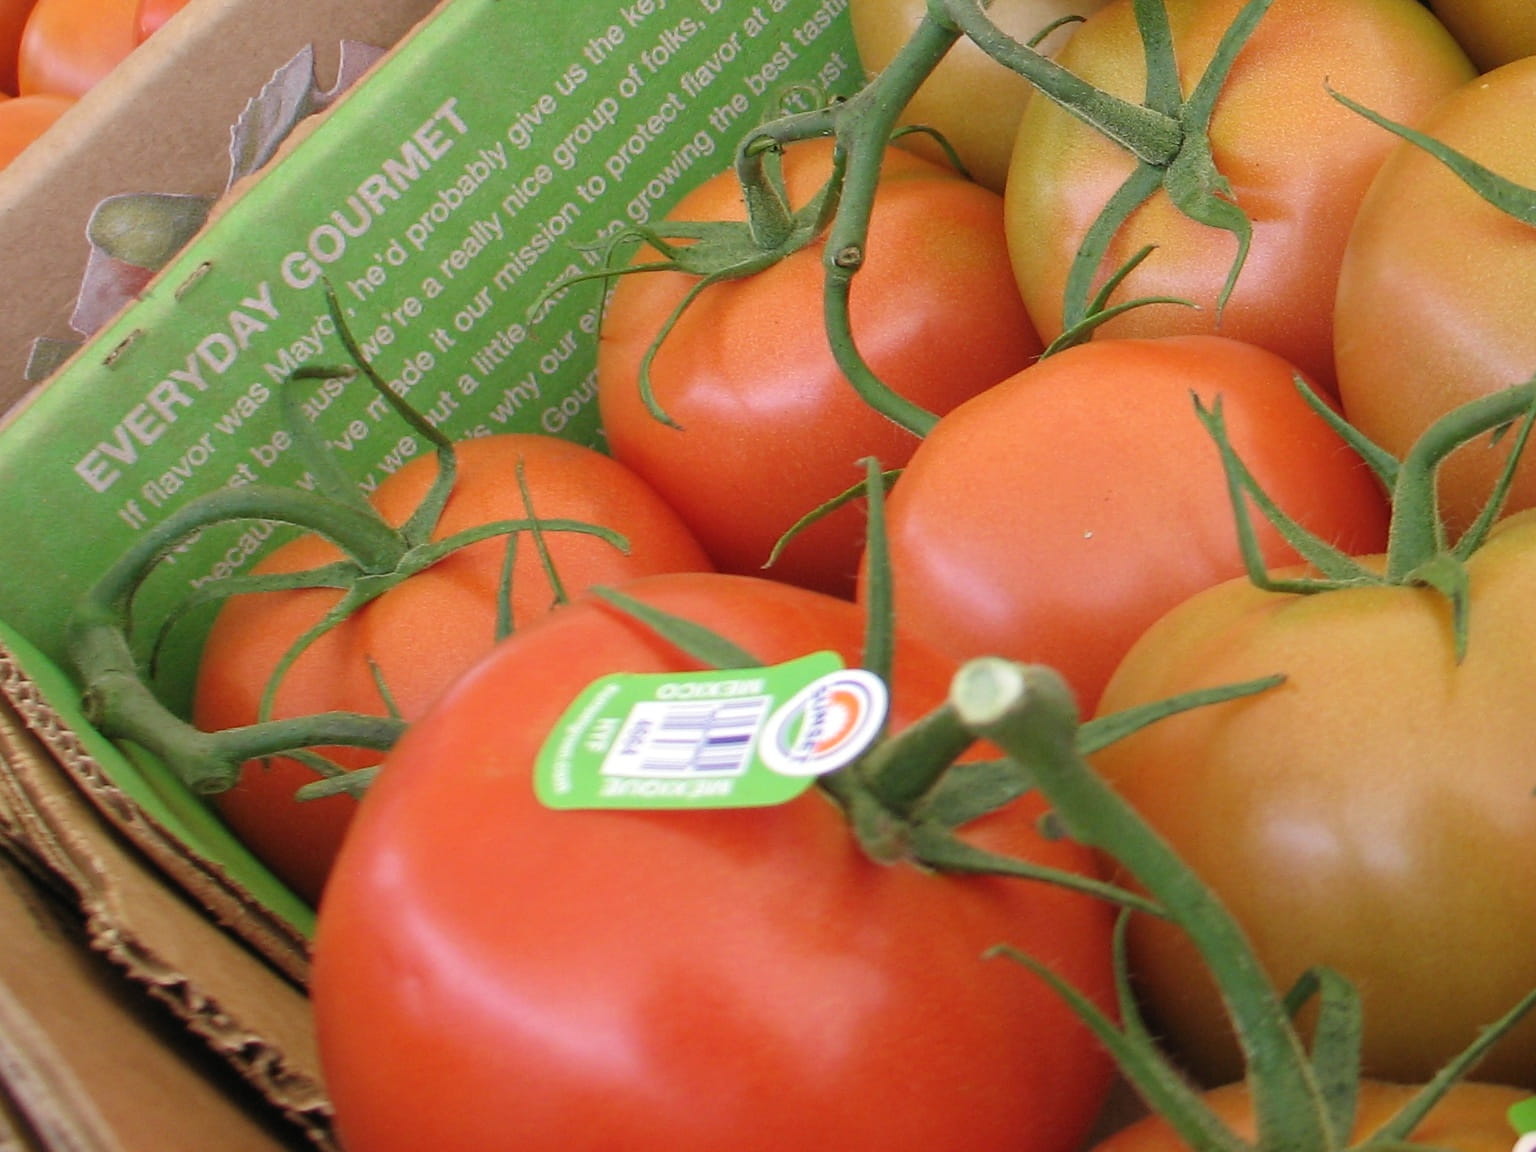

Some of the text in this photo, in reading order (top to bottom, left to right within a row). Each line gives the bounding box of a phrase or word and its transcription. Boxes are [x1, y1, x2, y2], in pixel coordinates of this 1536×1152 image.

[73, 96, 469, 493] EVERYDAY GOURMET
[119, 500, 147, 529] If
[142, 432, 216, 507] flavor
[214, 382, 271, 435] was
[263, 307, 356, 384] Mayo,
[346, 239, 409, 301] he'd
[405, 141, 510, 251] probably
[507, 94, 558, 150] give
[554, 63, 589, 96] us
[583, 24, 626, 65] the
[361, 296, 423, 363] we're
[421, 277, 446, 299] a
[439, 212, 505, 279] really
[502, 164, 554, 217] nice
[552, 97, 620, 171] group
[618, 63, 644, 99] of
[640, 17, 706, 73] folks,
[379, 436, 418, 474] we
[458, 374, 480, 395] a
[471, 324, 526, 375] little
[627, 130, 715, 225] growing
[709, 94, 749, 133] the
[745, 42, 799, 96] best
[429, 328, 457, 353] it
[454, 286, 493, 332] our
[494, 202, 581, 291] mission
[576, 175, 606, 203] to
[605, 92, 686, 182] protect
[680, 32, 742, 97] flavor
[743, 7, 770, 38] at
[490, 373, 540, 423] why
[540, 331, 578, 374] our
